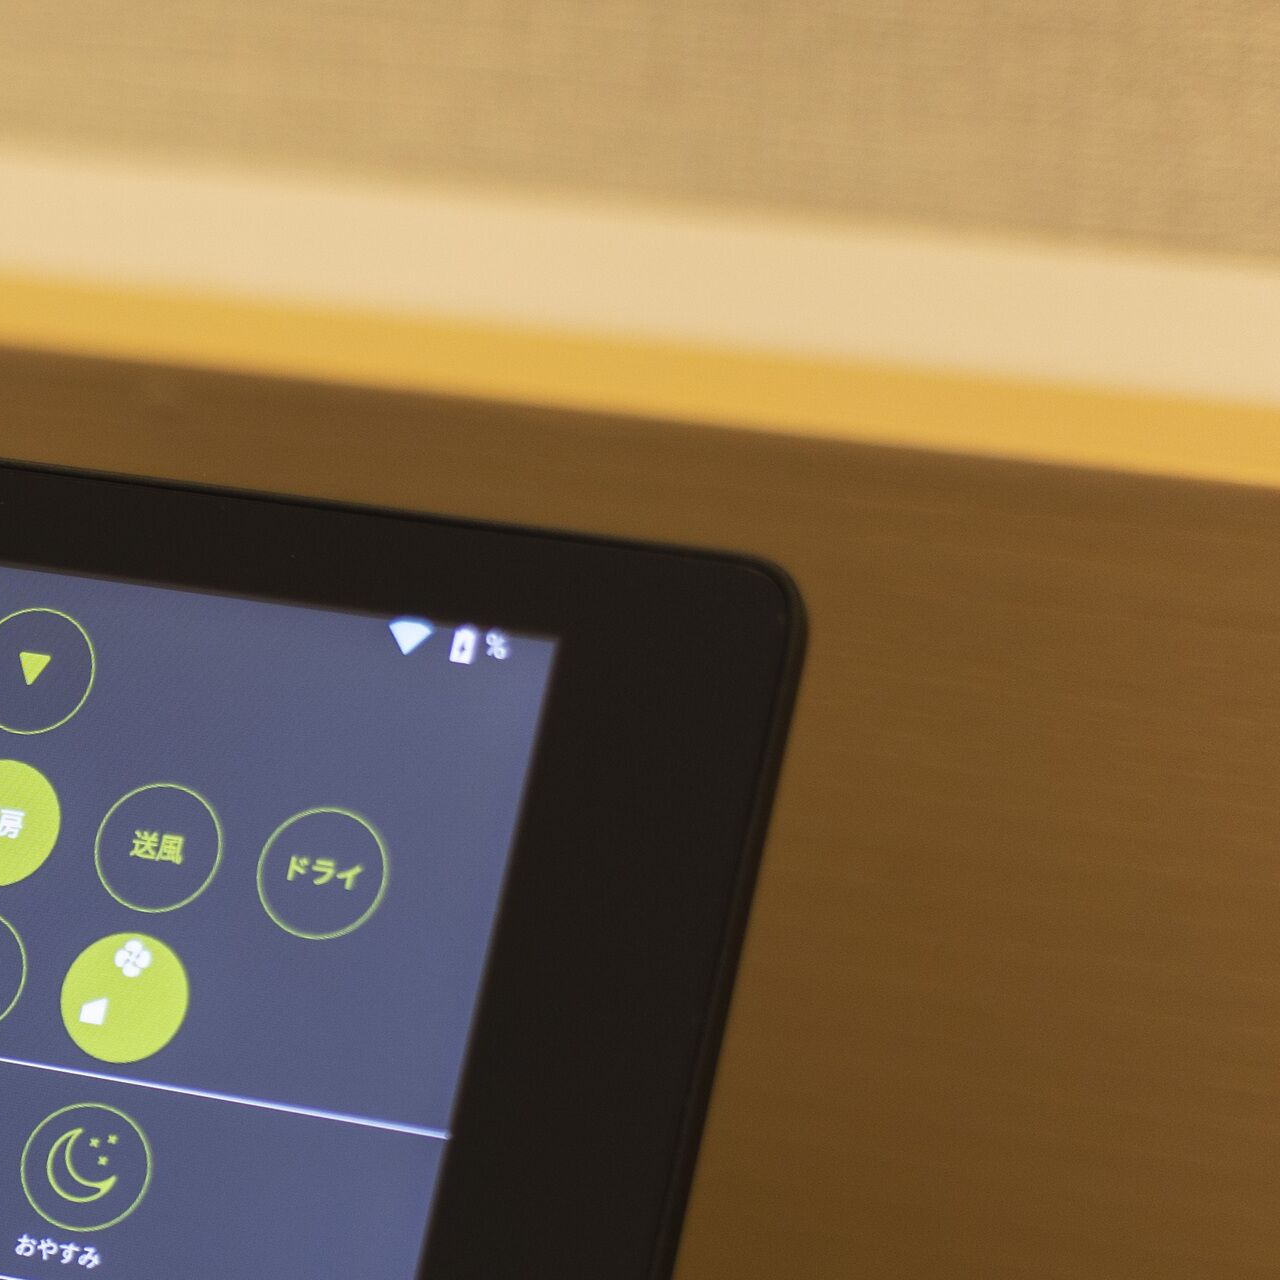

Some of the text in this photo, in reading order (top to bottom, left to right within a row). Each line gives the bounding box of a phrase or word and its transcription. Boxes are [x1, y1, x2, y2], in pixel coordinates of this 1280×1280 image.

[129, 829, 185, 866] 送風
[286, 855, 363, 891] ドライ
[14, 1233, 101, 1270] おやすみ
